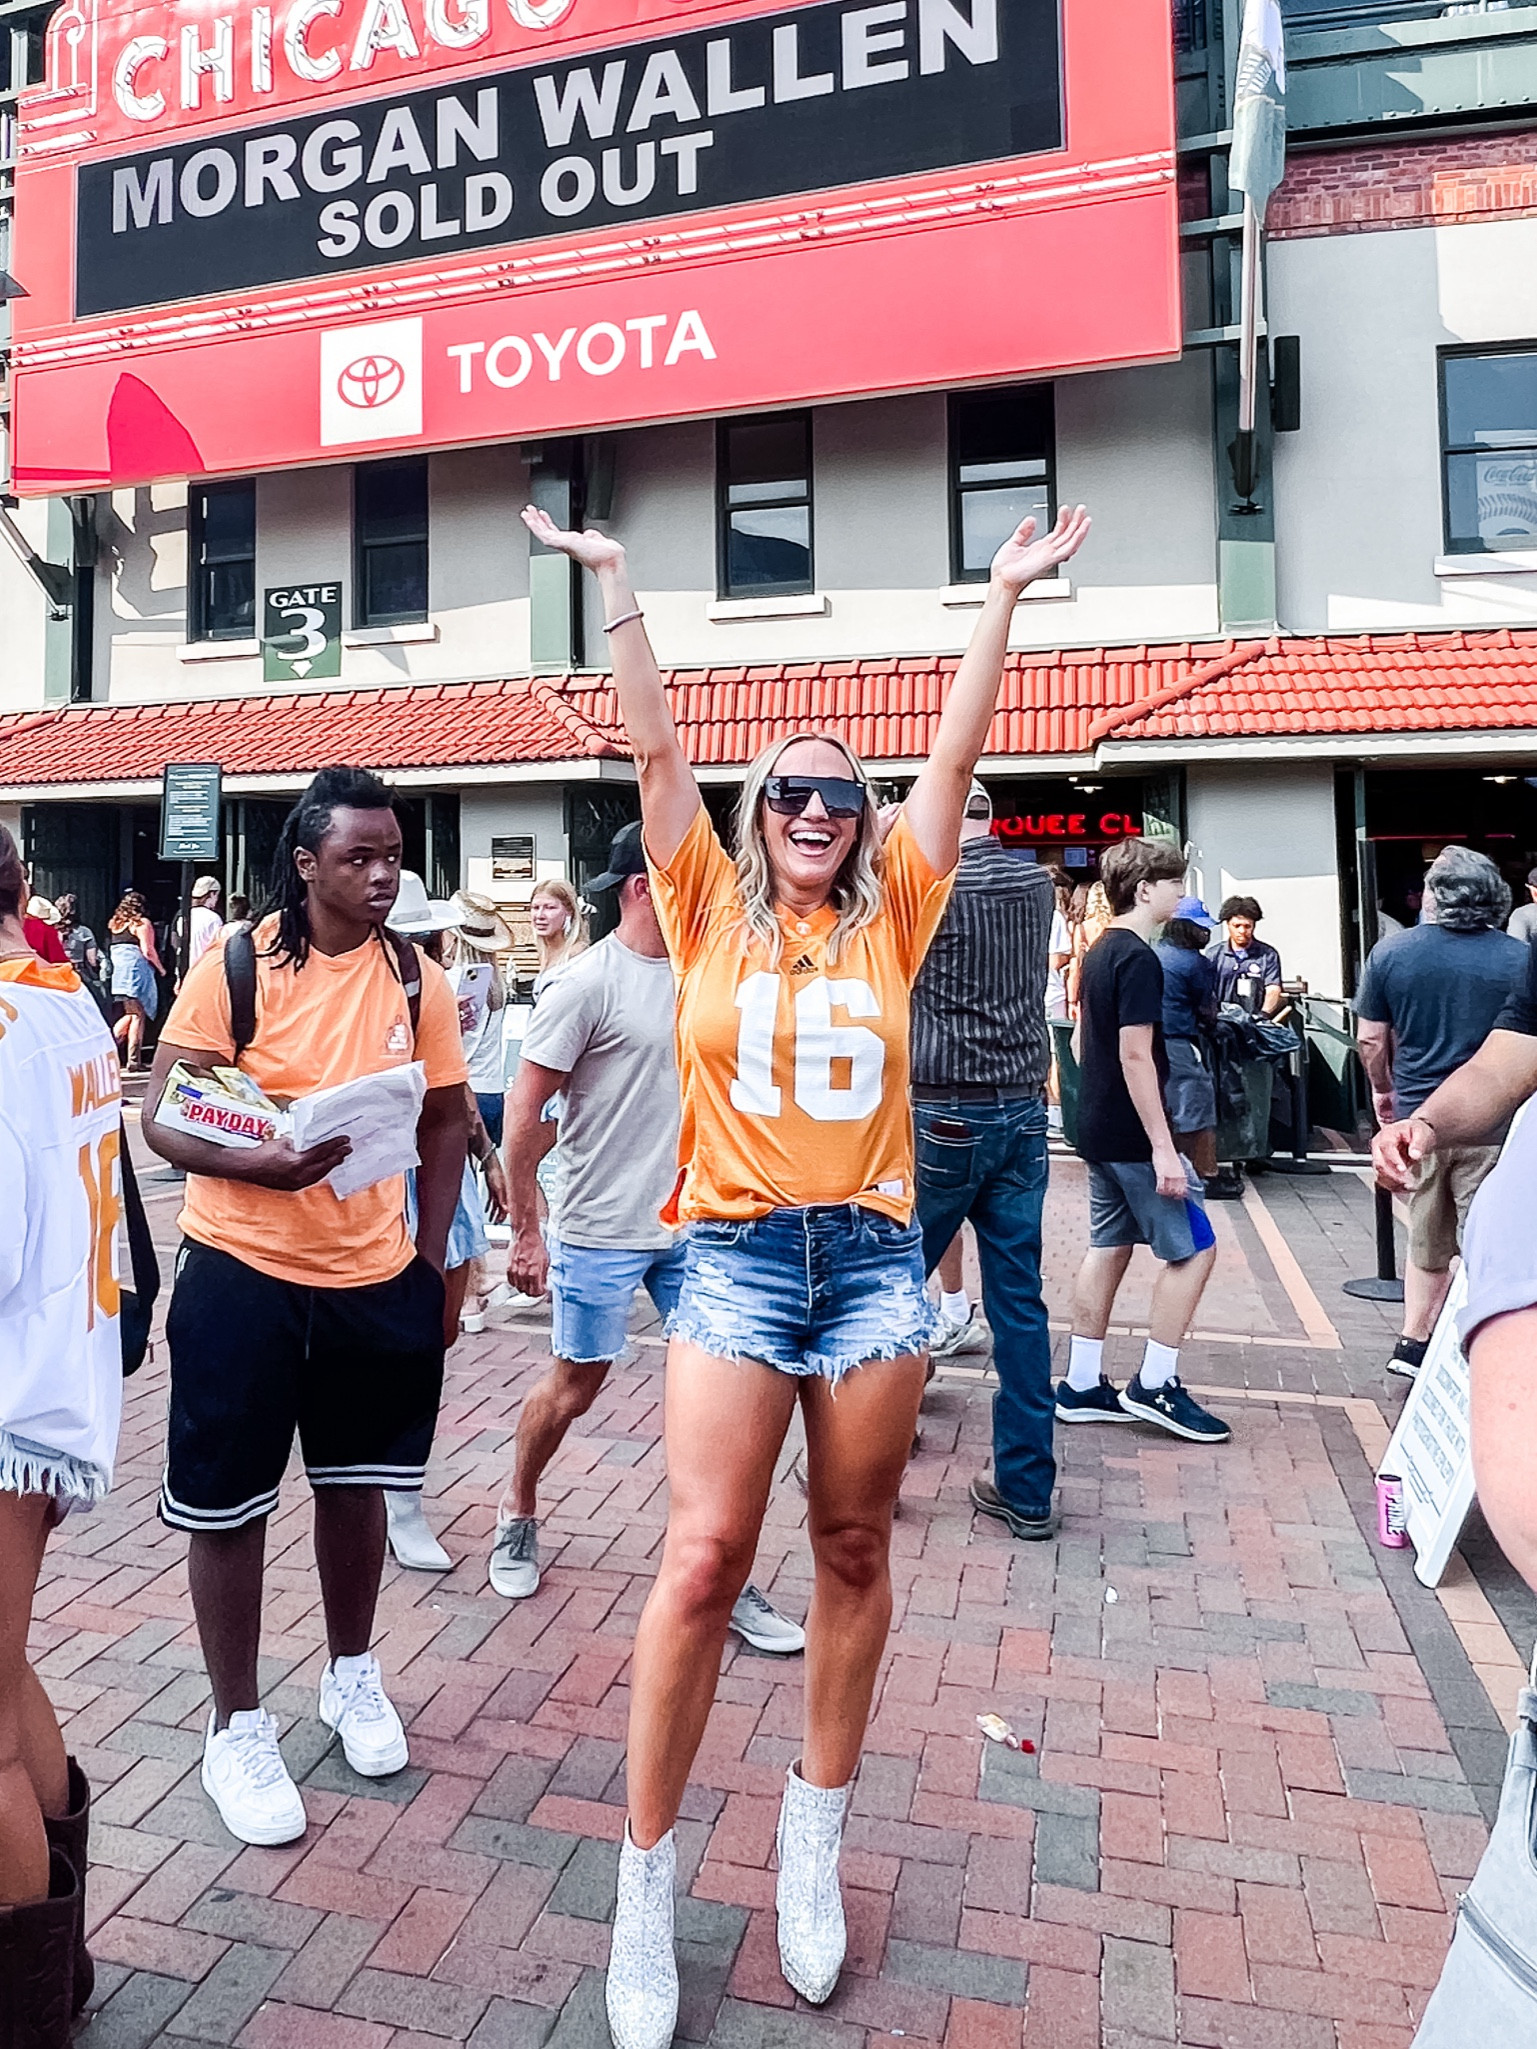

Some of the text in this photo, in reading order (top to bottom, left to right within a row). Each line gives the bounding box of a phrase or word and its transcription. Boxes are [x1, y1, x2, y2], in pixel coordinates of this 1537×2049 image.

[112, 0, 998, 234] MORGAN WALLEN
[317, 131, 714, 258] SOLD OUT
[447, 309, 717, 394] TOYOTA
[269, 586, 337, 608] GATE
[276, 607, 328, 660] 3
[730, 971, 885, 1121] 16
[188, 1104, 269, 1137] PAYDAY
